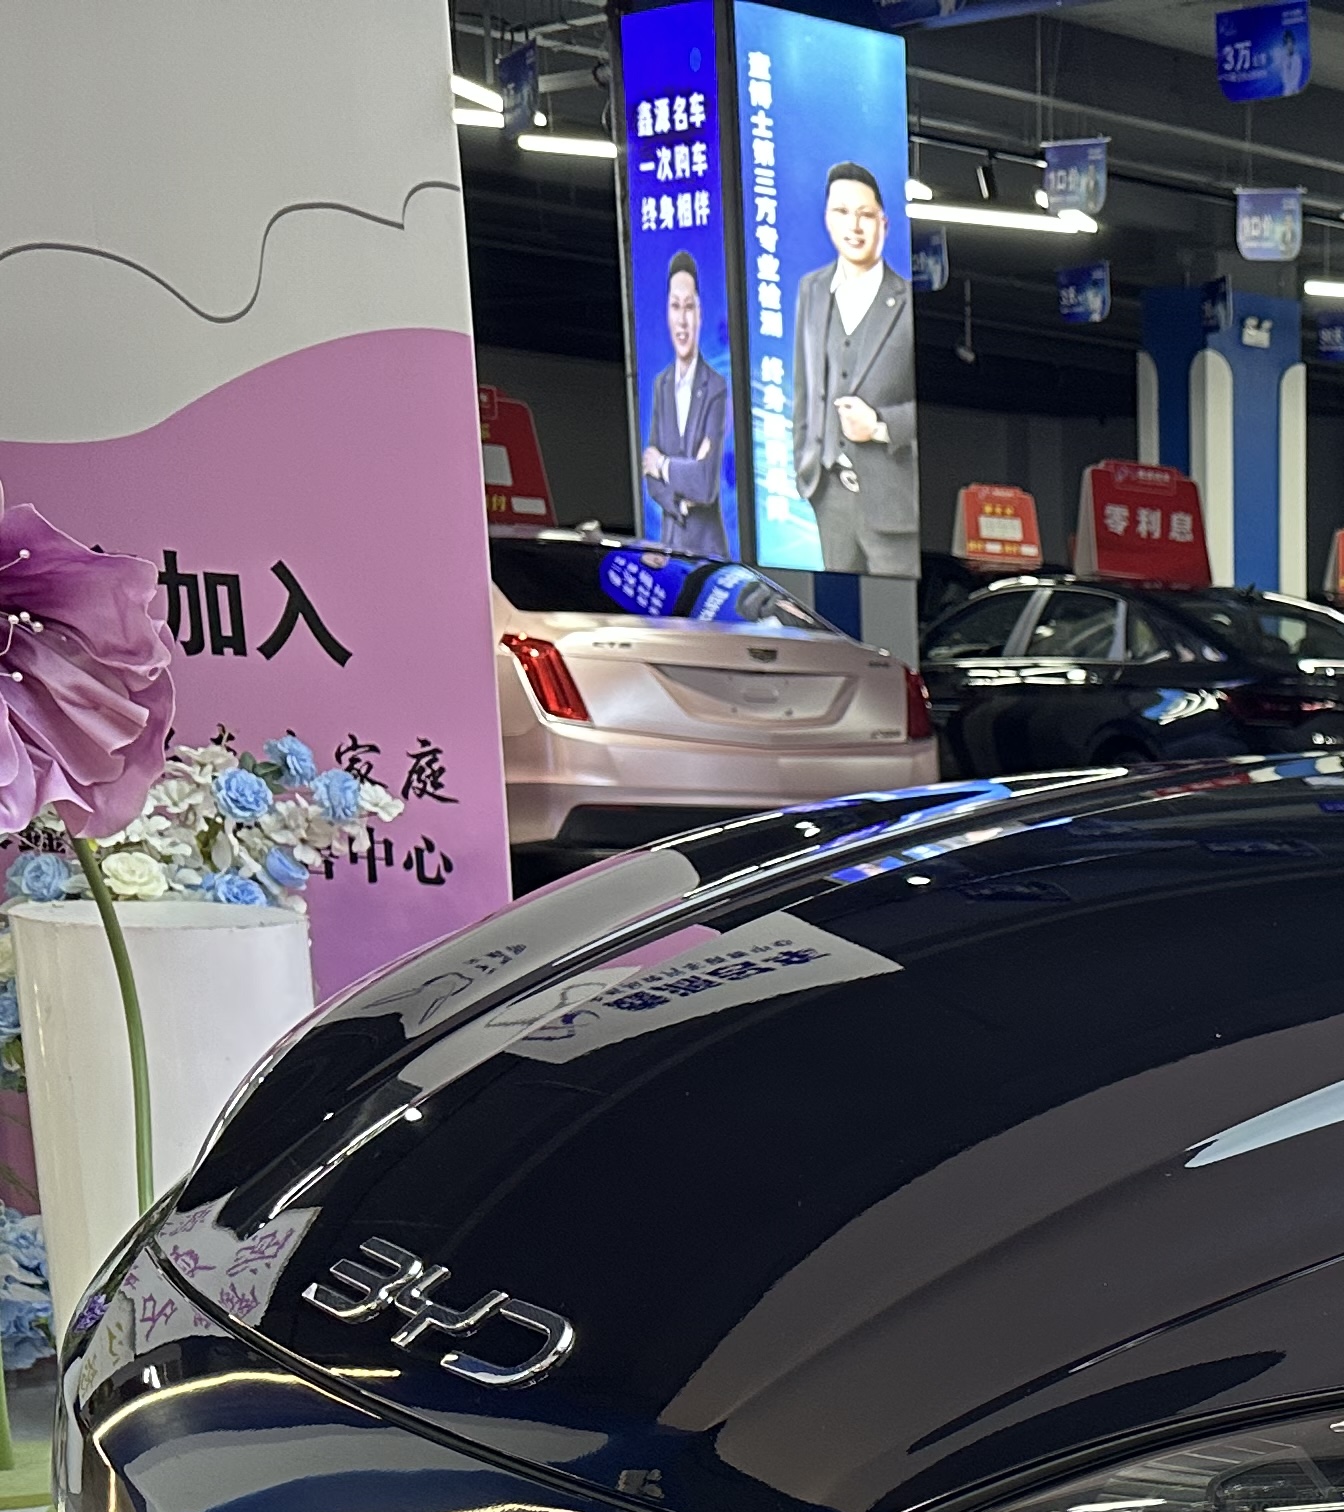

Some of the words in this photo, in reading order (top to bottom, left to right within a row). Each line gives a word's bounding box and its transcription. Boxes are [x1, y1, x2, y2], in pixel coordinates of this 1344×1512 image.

[639, 141, 708, 182] 一次购车
[641, 189, 710, 231] 终身相伴
[1104, 503, 1194, 542] 零利息
[302, 1235, 576, 1388] BYD
